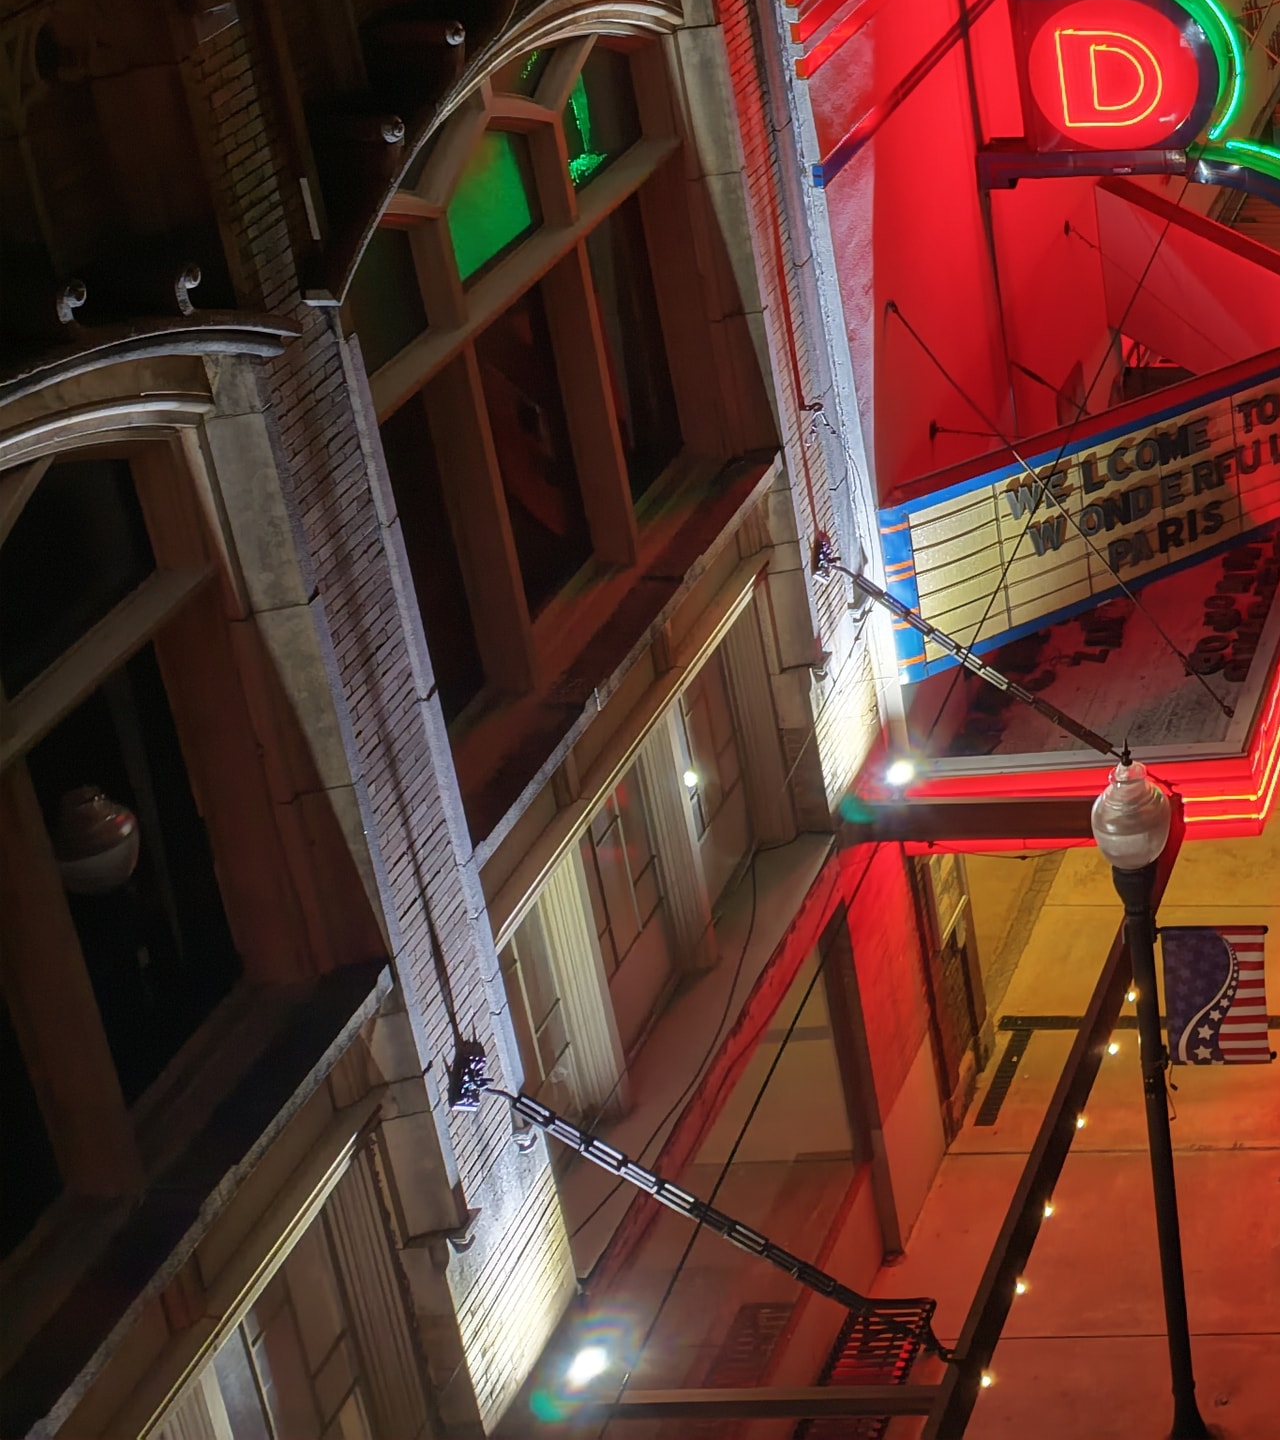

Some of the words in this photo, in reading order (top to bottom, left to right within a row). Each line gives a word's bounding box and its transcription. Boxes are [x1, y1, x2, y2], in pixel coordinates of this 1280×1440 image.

[1005, 415, 1211, 521] WELCOME
[1236, 393, 1280, 434] TO
[1107, 499, 1225, 574] PARIS
